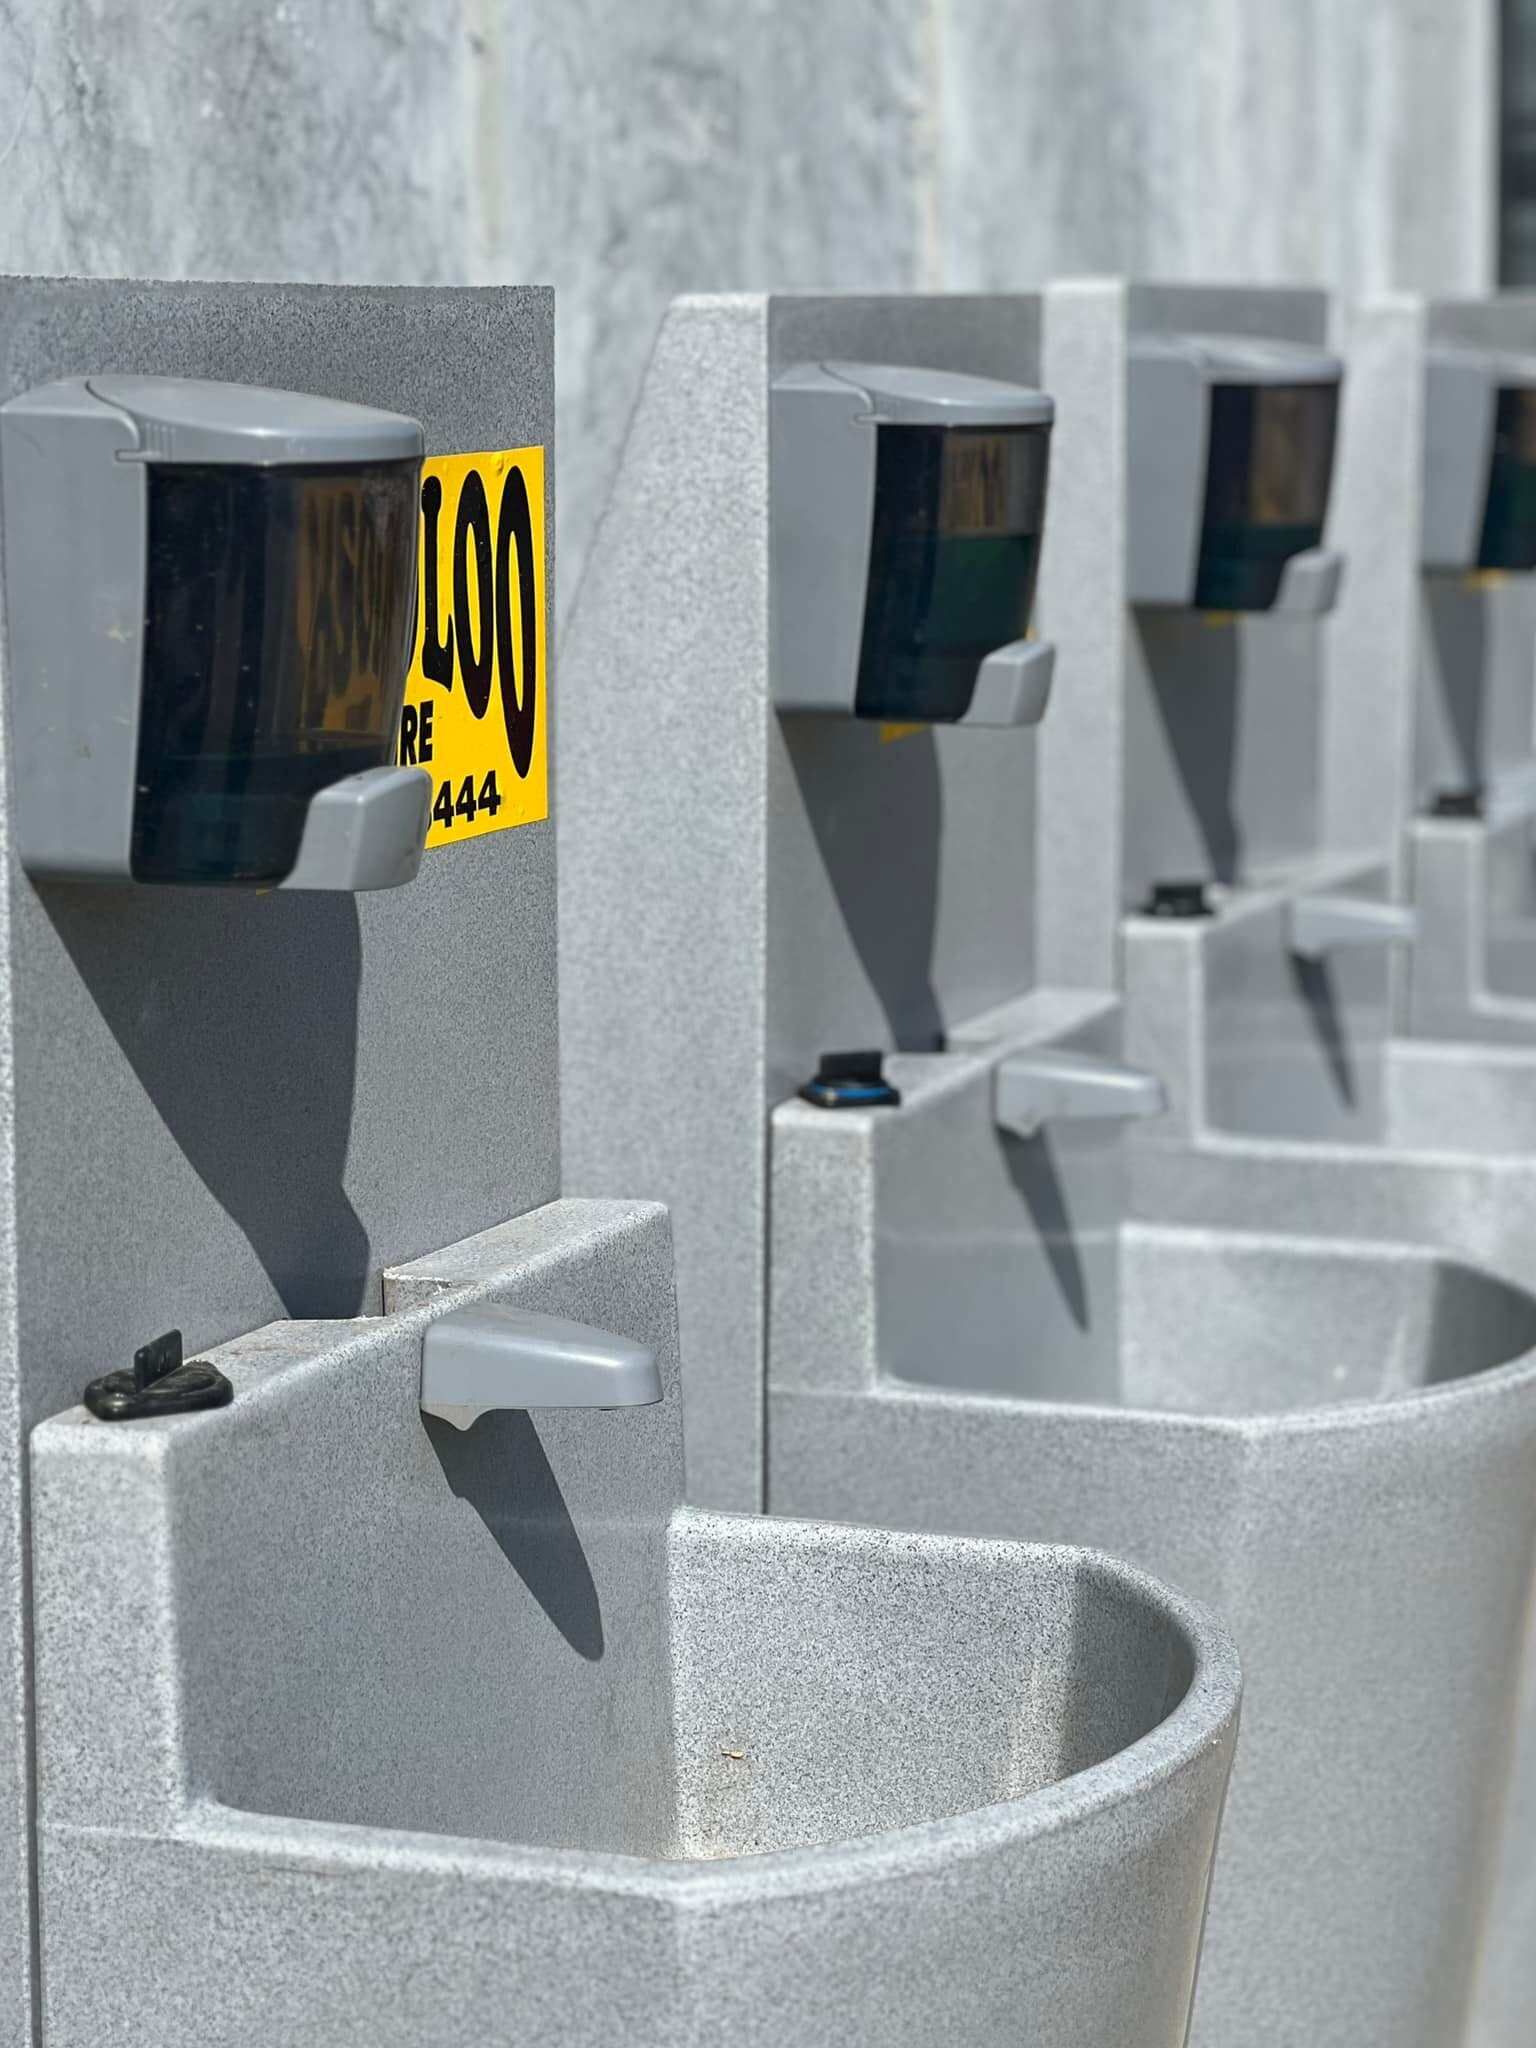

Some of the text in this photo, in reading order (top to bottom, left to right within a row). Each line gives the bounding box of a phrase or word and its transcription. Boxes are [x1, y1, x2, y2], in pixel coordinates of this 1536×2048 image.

[408, 465, 536, 779] LOO
[395, 700, 434, 767] RE
[427, 770, 502, 832] 444
